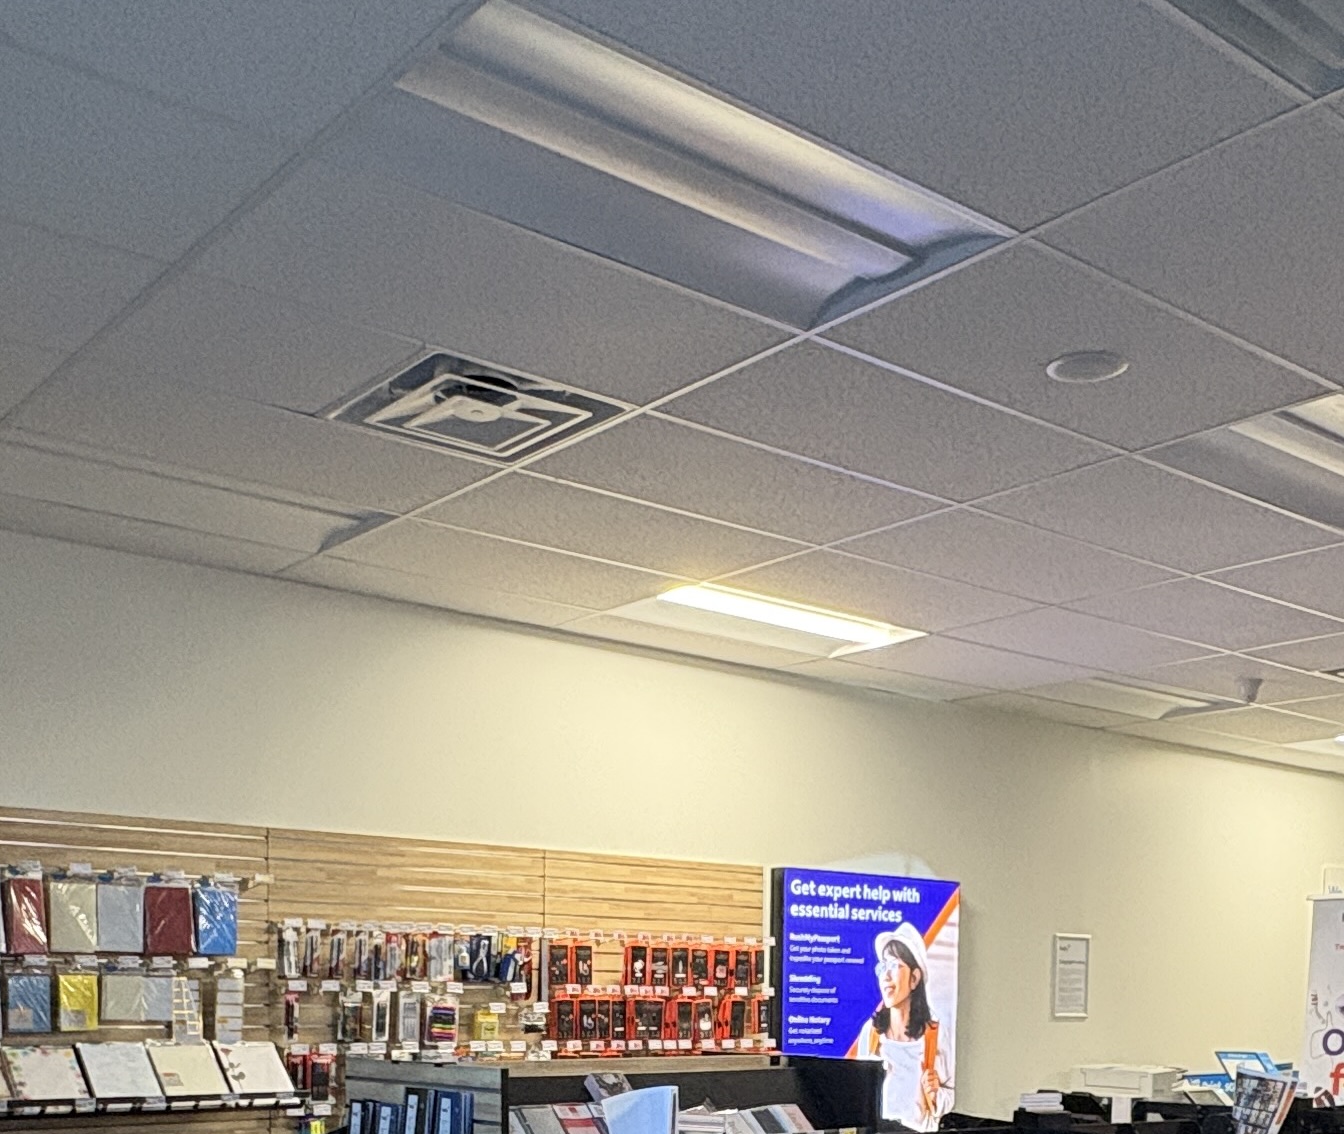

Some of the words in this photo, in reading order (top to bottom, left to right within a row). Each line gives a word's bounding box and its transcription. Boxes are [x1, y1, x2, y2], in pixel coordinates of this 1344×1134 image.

[790, 879, 816, 896] Get
[818, 884, 862, 901] expert
[863, 884, 891, 905] help
[892, 886, 921, 904] with
[790, 903, 850, 920] essential
[851, 906, 903, 923] services
